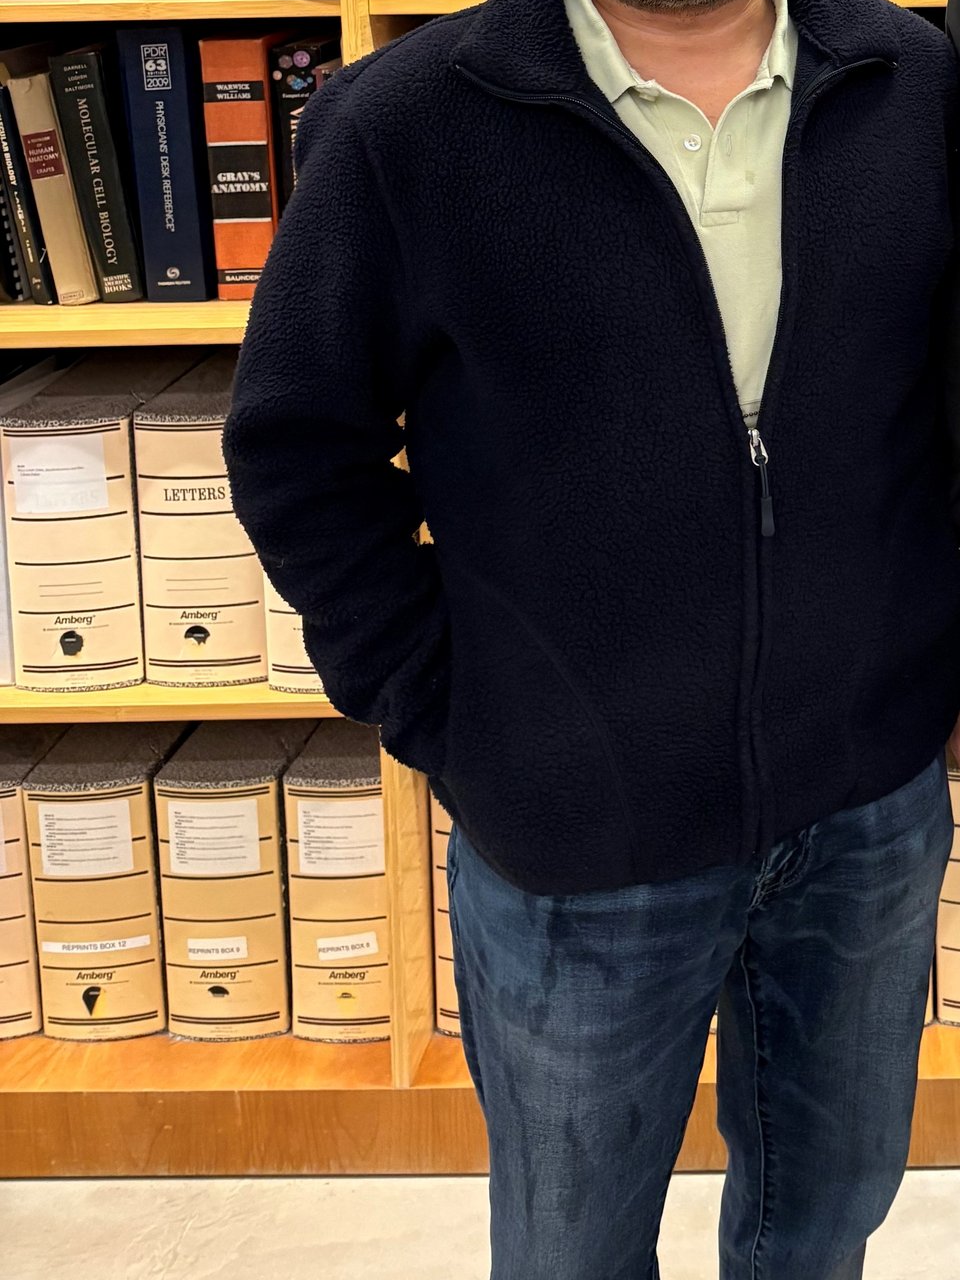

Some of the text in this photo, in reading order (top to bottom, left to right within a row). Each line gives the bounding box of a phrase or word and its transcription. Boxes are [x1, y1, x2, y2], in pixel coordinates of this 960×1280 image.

[144, 47, 165, 57] PDR
[145, 59, 167, 71] 63
[65, 83, 95, 93] BALTIMORE
[147, 78, 169, 88] 2009
[155, 101, 168, 153] PHYSICIANS'
[29, 146, 53, 155] HUMAN
[160, 156, 171, 178] DESK
[77, 98, 118, 265] MOLECULAR CELL BIOLOGY
[217, 172, 260, 182] GRAY'S
[211, 183, 268, 193] ANATOMY
[103, 273, 130, 281] SCIENTIFIC
[104, 278, 131, 287] AMERICAN
[104, 284, 132, 294] BOOKS
[164, 486, 226, 501] LETTERS
[54, 614, 93, 625] Amberg
[180, 610, 217, 621] Amberg
[62, 940, 127, 952] REPRINTS BOX 12
[188, 947, 219, 955] REPRINTS
[318, 945, 349, 954] REPRINTS
[76, 970, 112, 981] Amberg
[199, 970, 236, 980] Amberg
[329, 970, 365, 980] Amberg
